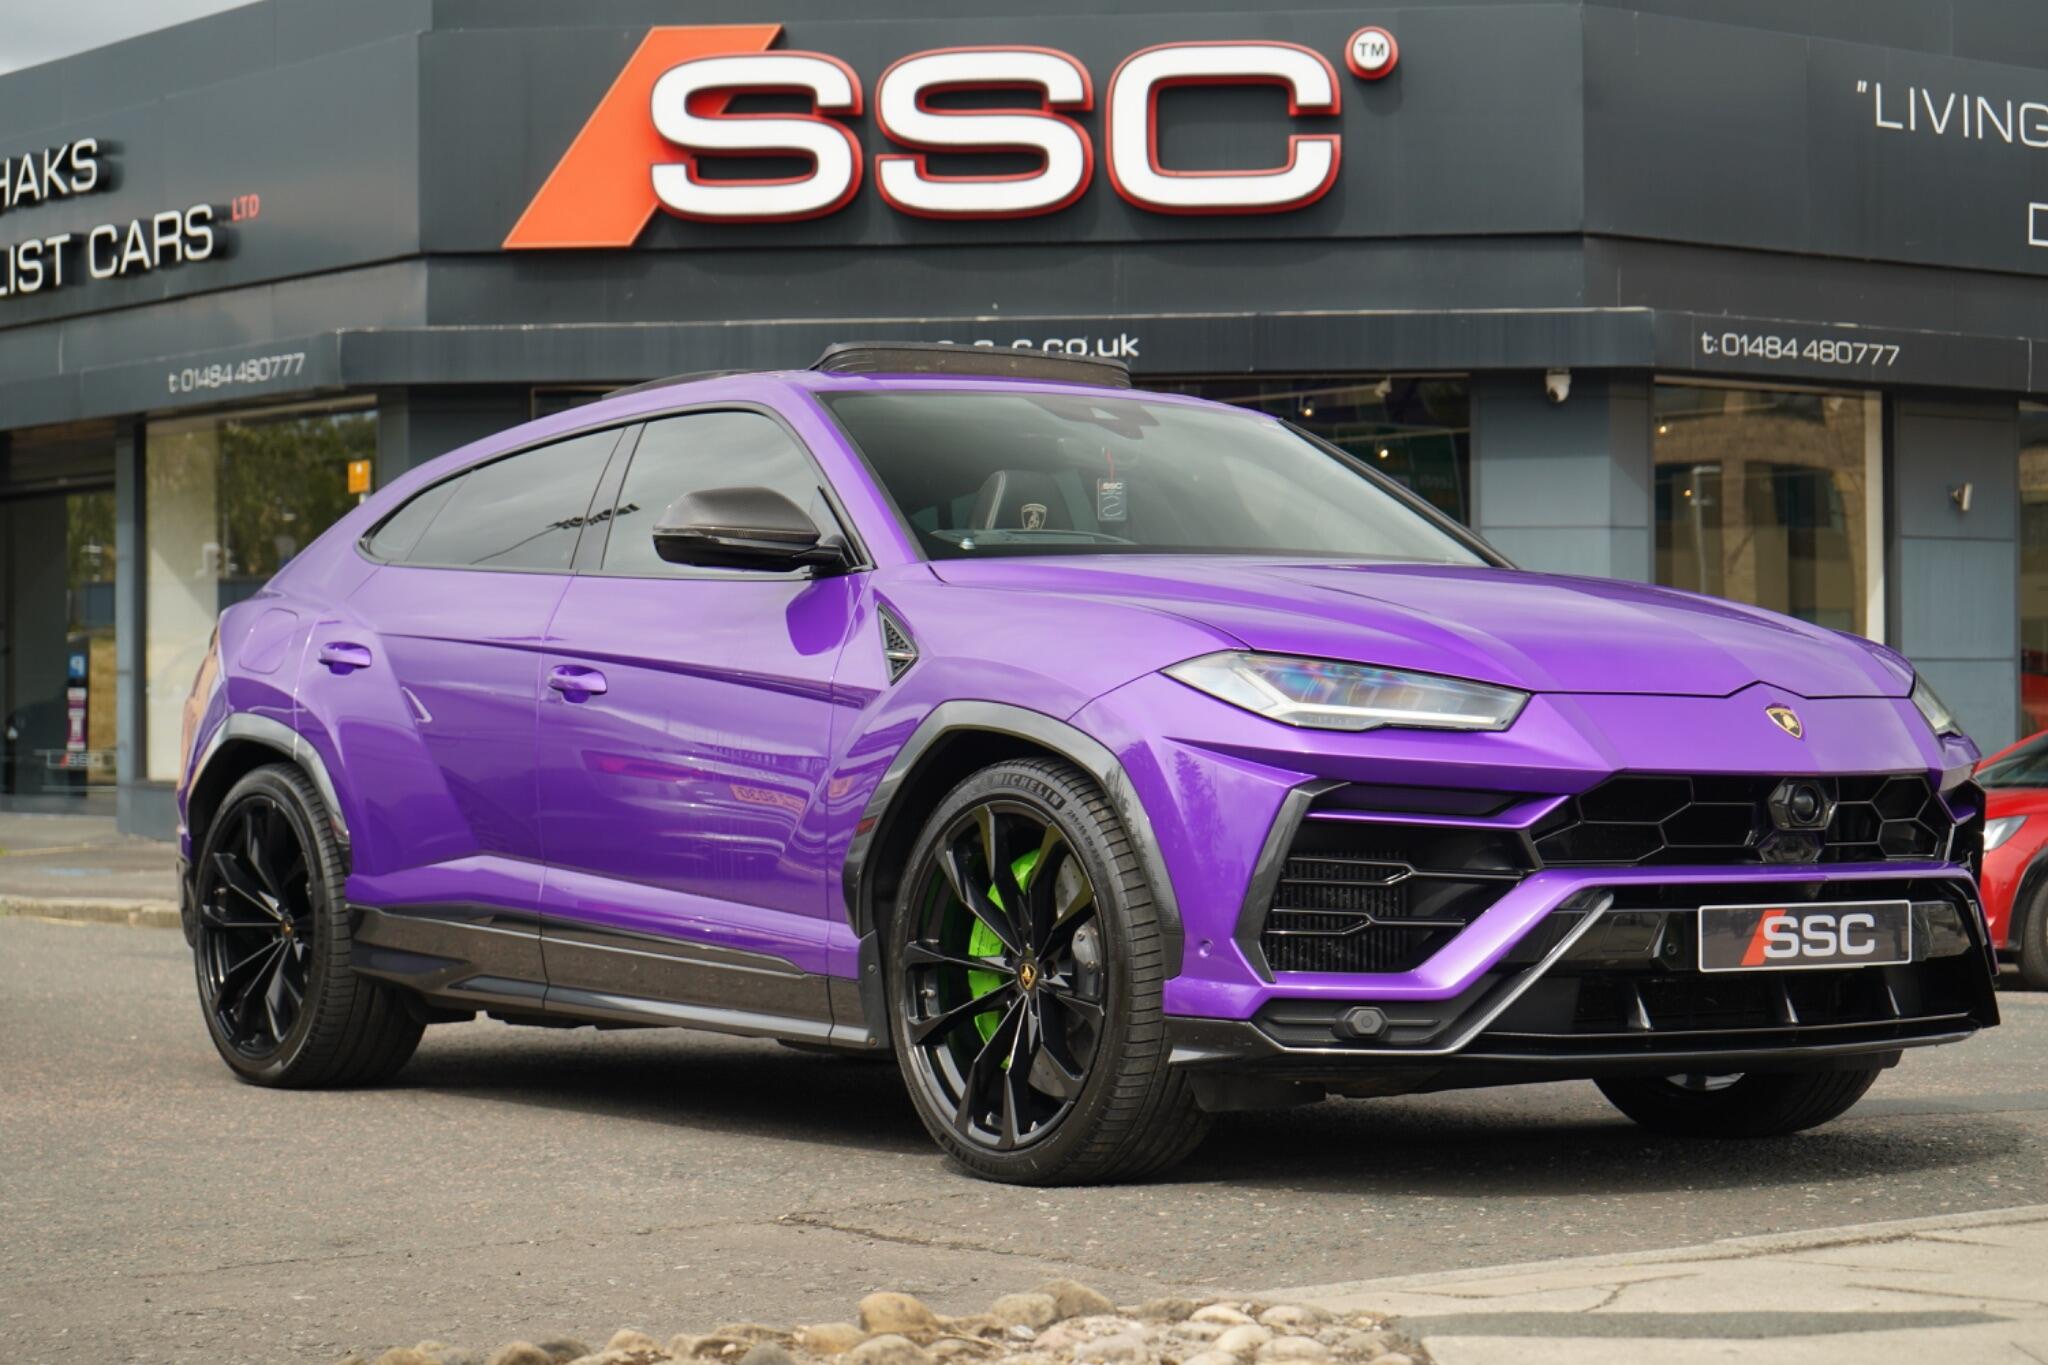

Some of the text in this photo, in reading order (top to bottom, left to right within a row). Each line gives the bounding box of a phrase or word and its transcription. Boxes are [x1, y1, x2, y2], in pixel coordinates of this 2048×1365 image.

[1357, 42, 1386, 57] TM
[650, 41, 1342, 221] SSC
[232, 194, 260, 221] LTD
[0, 204, 214, 296] IST CARS
[234, 352, 306, 383] 480777
[1802, 339, 1900, 367] 480777
[991, 773, 1063, 807] MICHELIN
[1763, 913, 1876, 958] SSC
